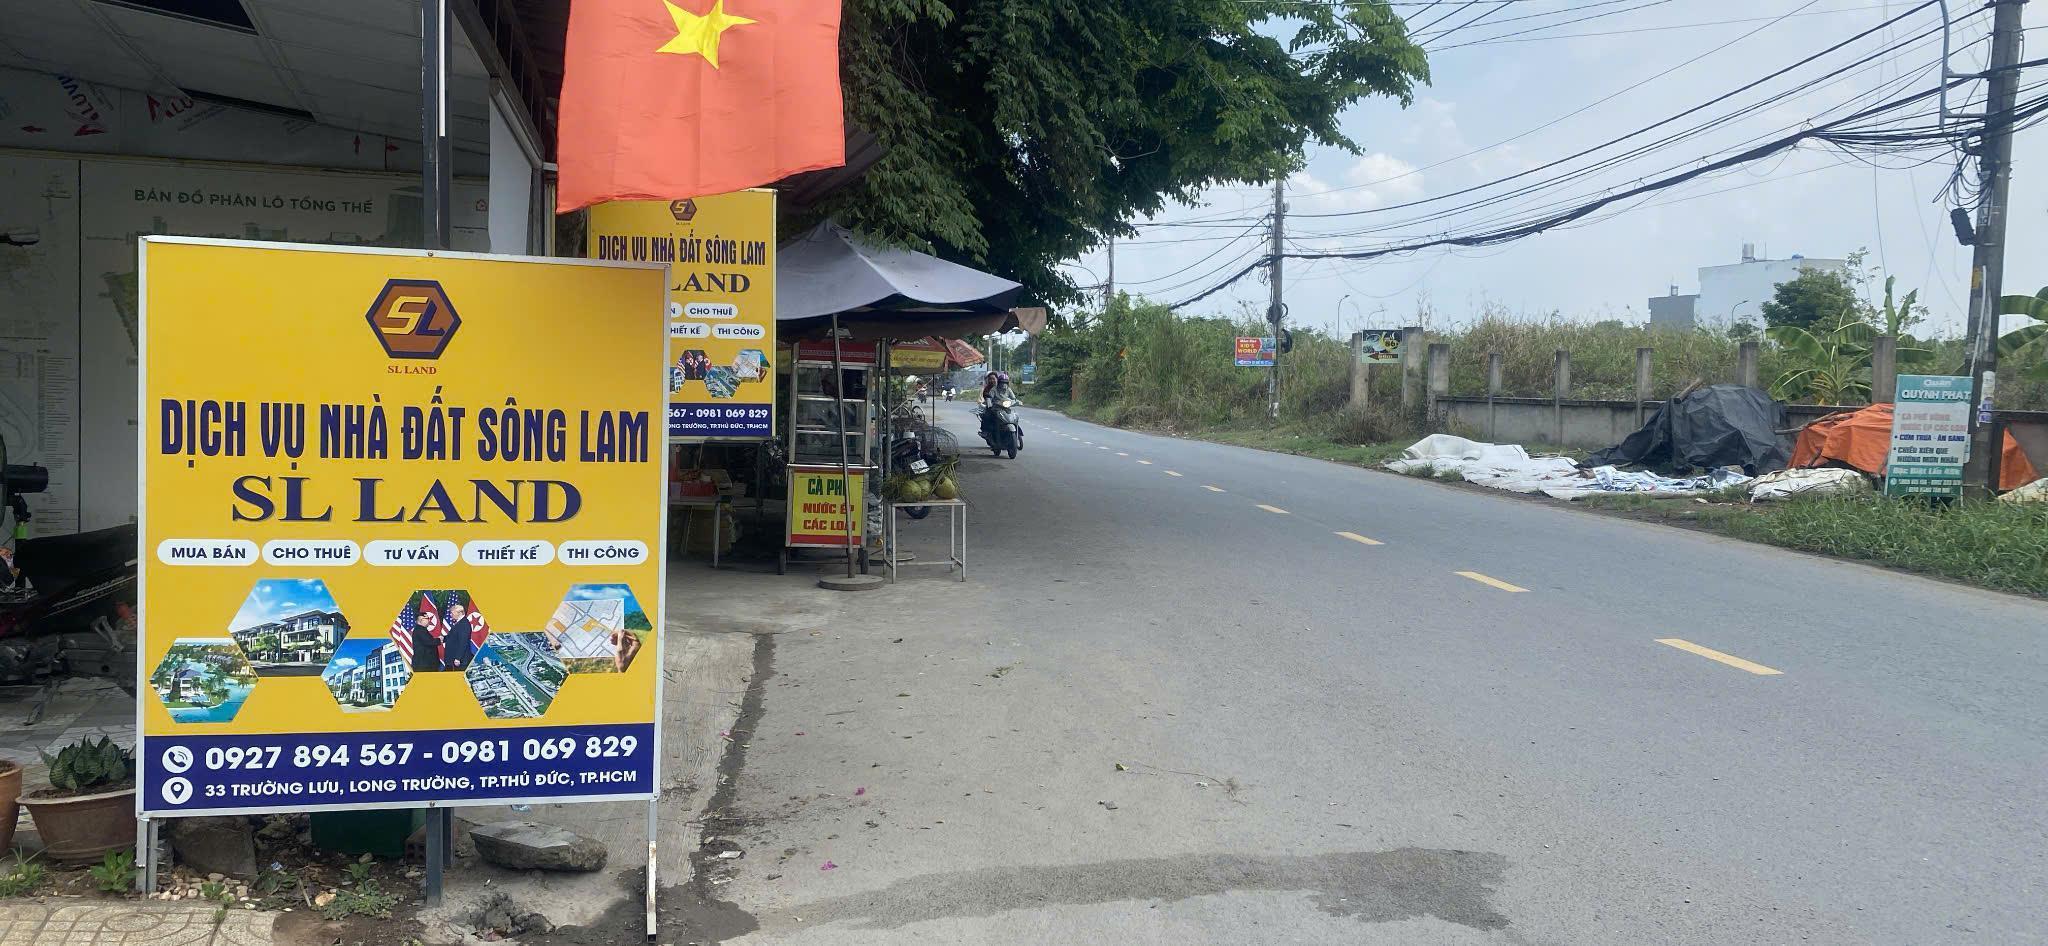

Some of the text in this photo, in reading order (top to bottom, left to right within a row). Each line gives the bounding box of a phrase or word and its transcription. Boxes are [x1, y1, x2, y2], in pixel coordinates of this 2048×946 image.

[134, 187, 374, 214] BẢN ĐỒ PHÂN LÔ TỔNG THỂ
[652, 232, 676, 263] NHÀ
[679, 228, 702, 263] ĐẤT
[705, 234, 737, 265] SÔNG
[741, 240, 766, 266] LAM
[380, 295, 446, 336] SL
[689, 307, 733, 316] CHO THUÊ
[671, 325, 702, 335] HIẾT KẾ
[717, 326, 760, 336] THI CÔNG
[387, 365, 437, 375] SL LAND
[696, 408, 721, 418] 0981
[725, 409, 746, 418] 069
[748, 409, 768, 419] 829
[161, 385, 649, 471] DỊCH VỤ NHÀ ĐẤT SÔNG LAM
[807, 475, 824, 496] CÀ
[231, 474, 584, 525] SL LAND
[802, 501, 837, 515] NƯỚC
[803, 517, 828, 531] CÁC
[171, 544, 247, 560] MUA BÁN
[272, 544, 351, 560] CHO THUÊ
[384, 544, 439, 561] TƯ VẤN
[477, 544, 541, 561] THIẾT KẾ
[567, 545, 640, 560] THI CÔNG
[205, 746, 282, 770] 0927
[293, 744, 350, 768] 894
[359, 743, 415, 766] 567
[441, 740, 510, 764] 0981
[522, 737, 577, 761] 069
[585, 735, 638, 759] 829
[205, 770, 637, 797] 33 TRƯỜNG LƯU, LONG TRƯỜNG, TP.THỦ ĐỨC, TP.HCM
